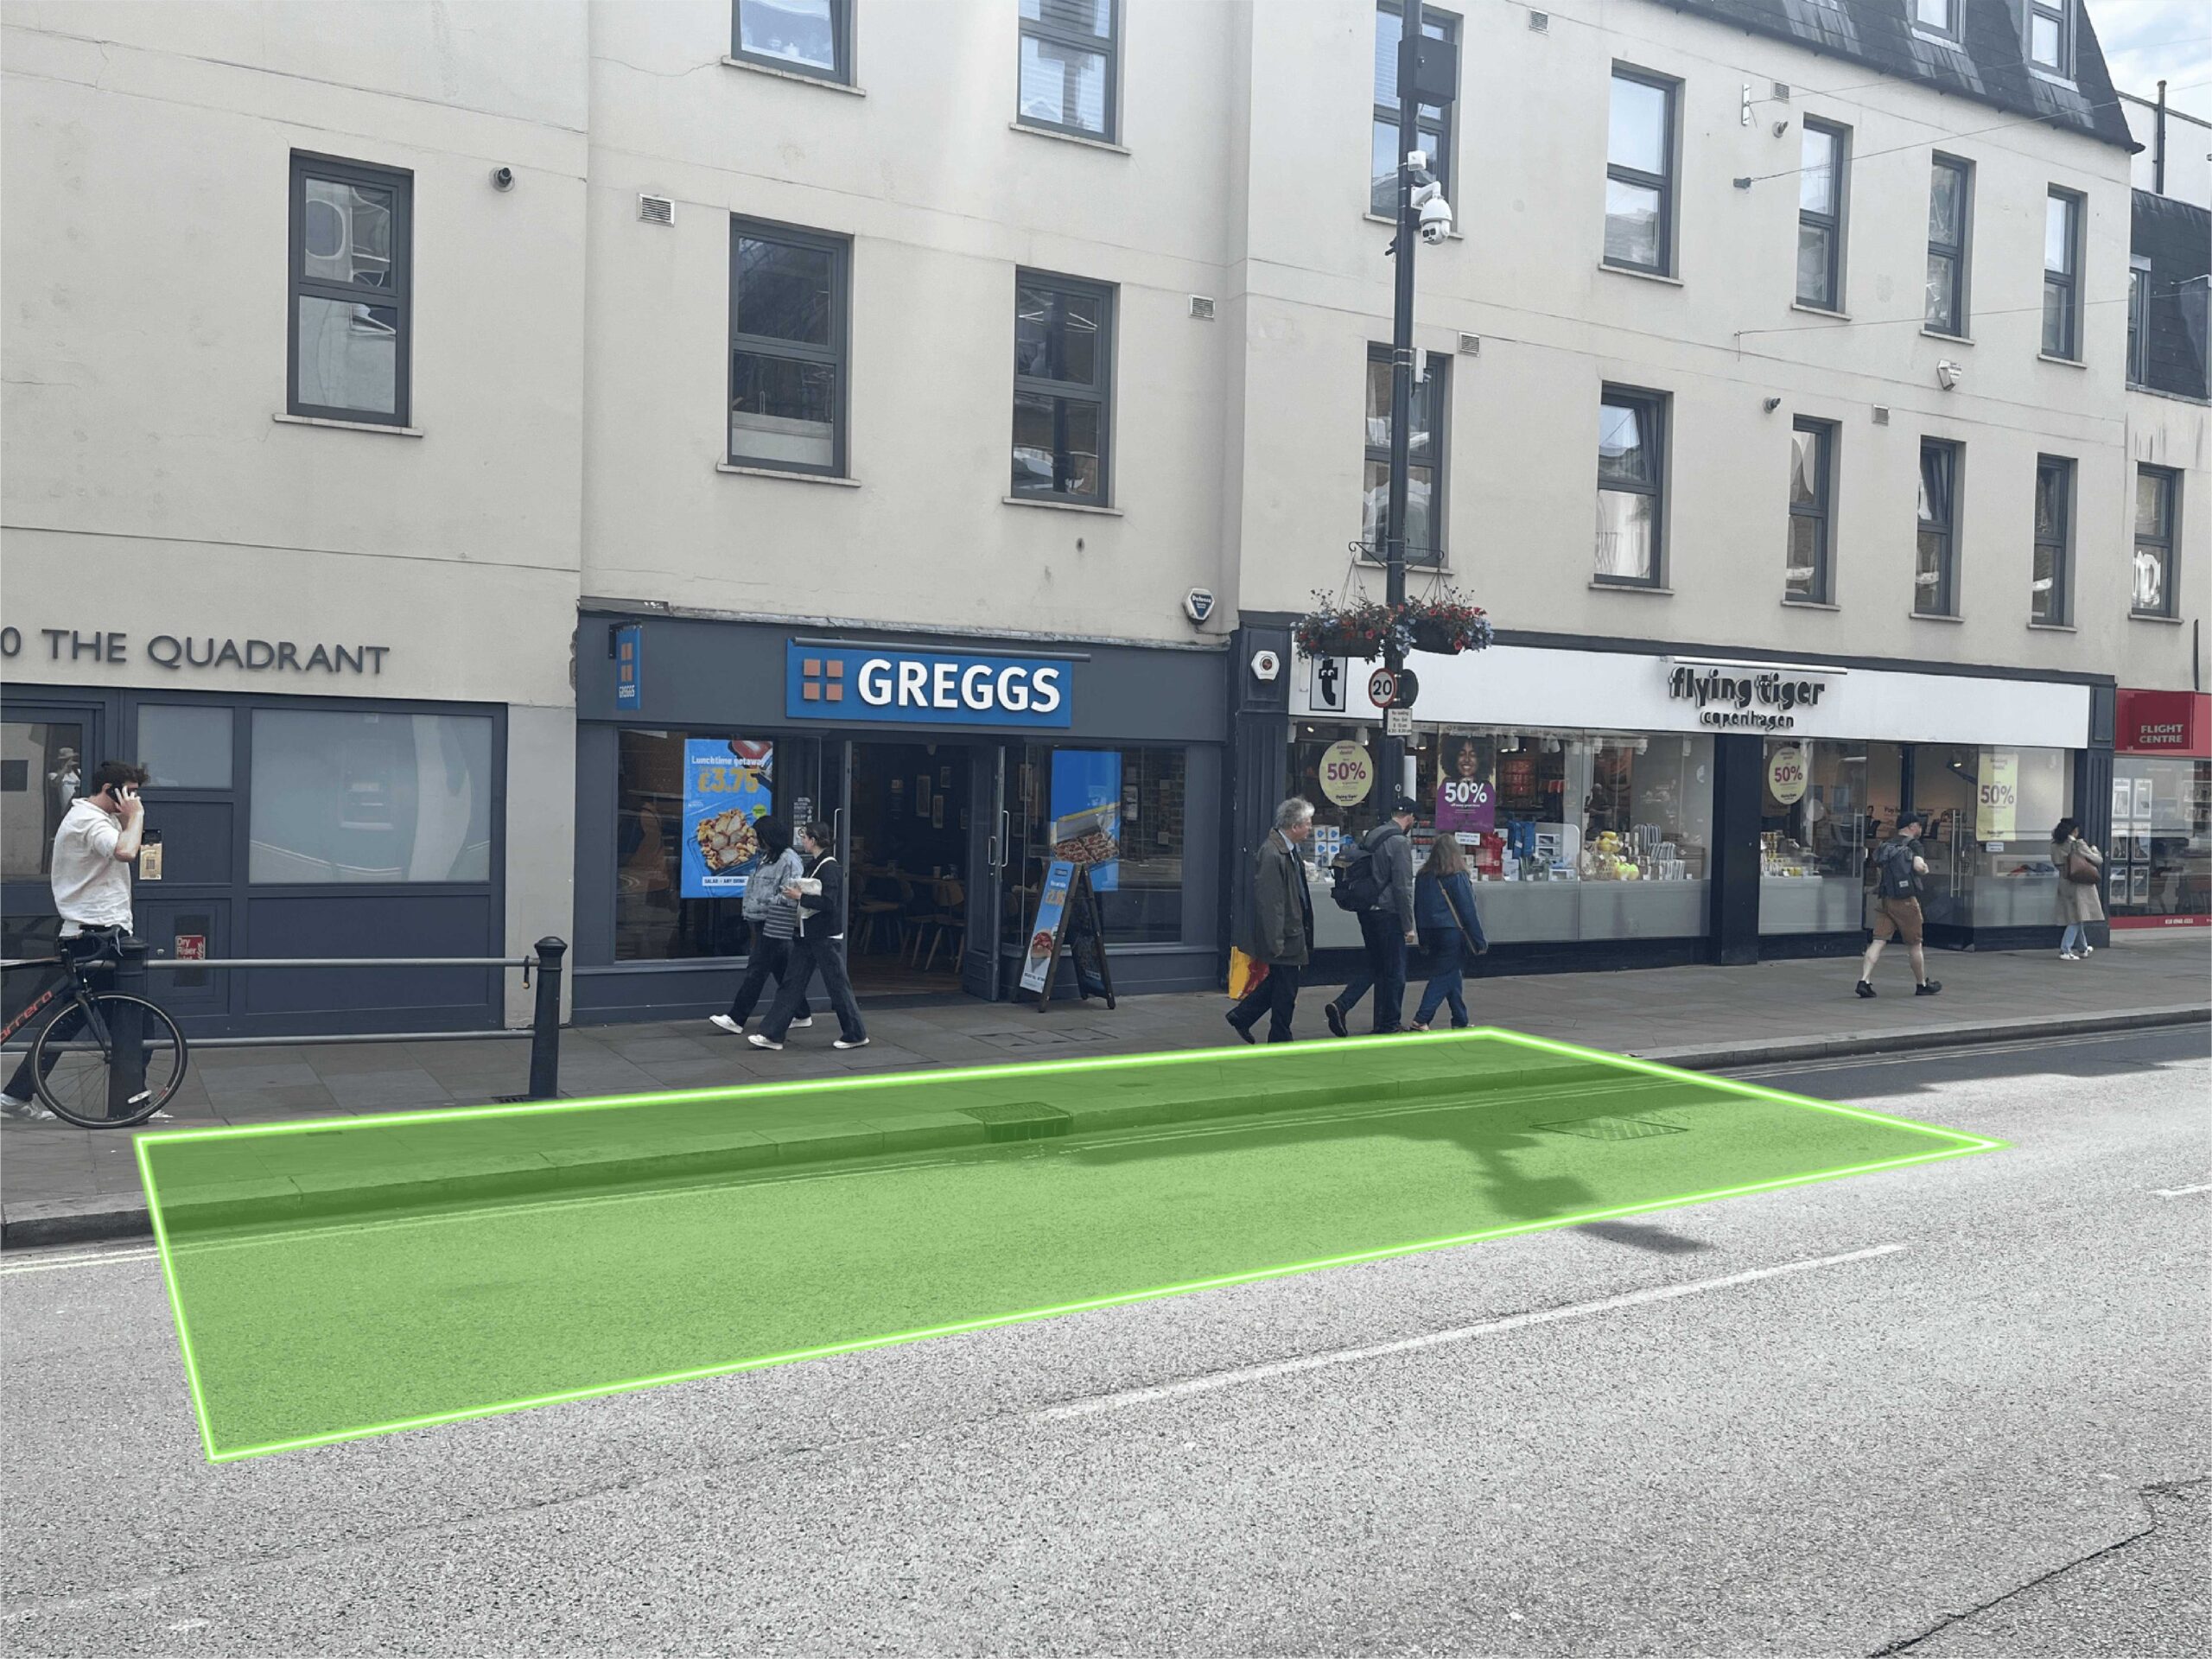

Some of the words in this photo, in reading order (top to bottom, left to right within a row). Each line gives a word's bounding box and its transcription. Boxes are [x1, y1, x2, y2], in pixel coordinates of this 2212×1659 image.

[41, 628, 127, 663] THE
[148, 635, 390, 674] QUADRANT
[858, 658, 1060, 713] GREGGS
[1373, 679, 1392, 696] 20
[1669, 667, 1753, 709] flying
[1755, 672, 1825, 710] tiger
[1700, 710, 1794, 731] copenhagen
[2140, 724, 2183, 734] FLIGHT
[2139, 734, 2183, 744] CENTRE
[691, 755, 732, 765] Lunchtime
[698, 766, 759, 793] £3.75
[1327, 761, 1367, 781] 50%
[1775, 765, 1803, 783] 50%
[1444, 782, 1488, 803] 50%
[1980, 785, 2014, 804] 50%
[177, 938, 190, 948] Dry
